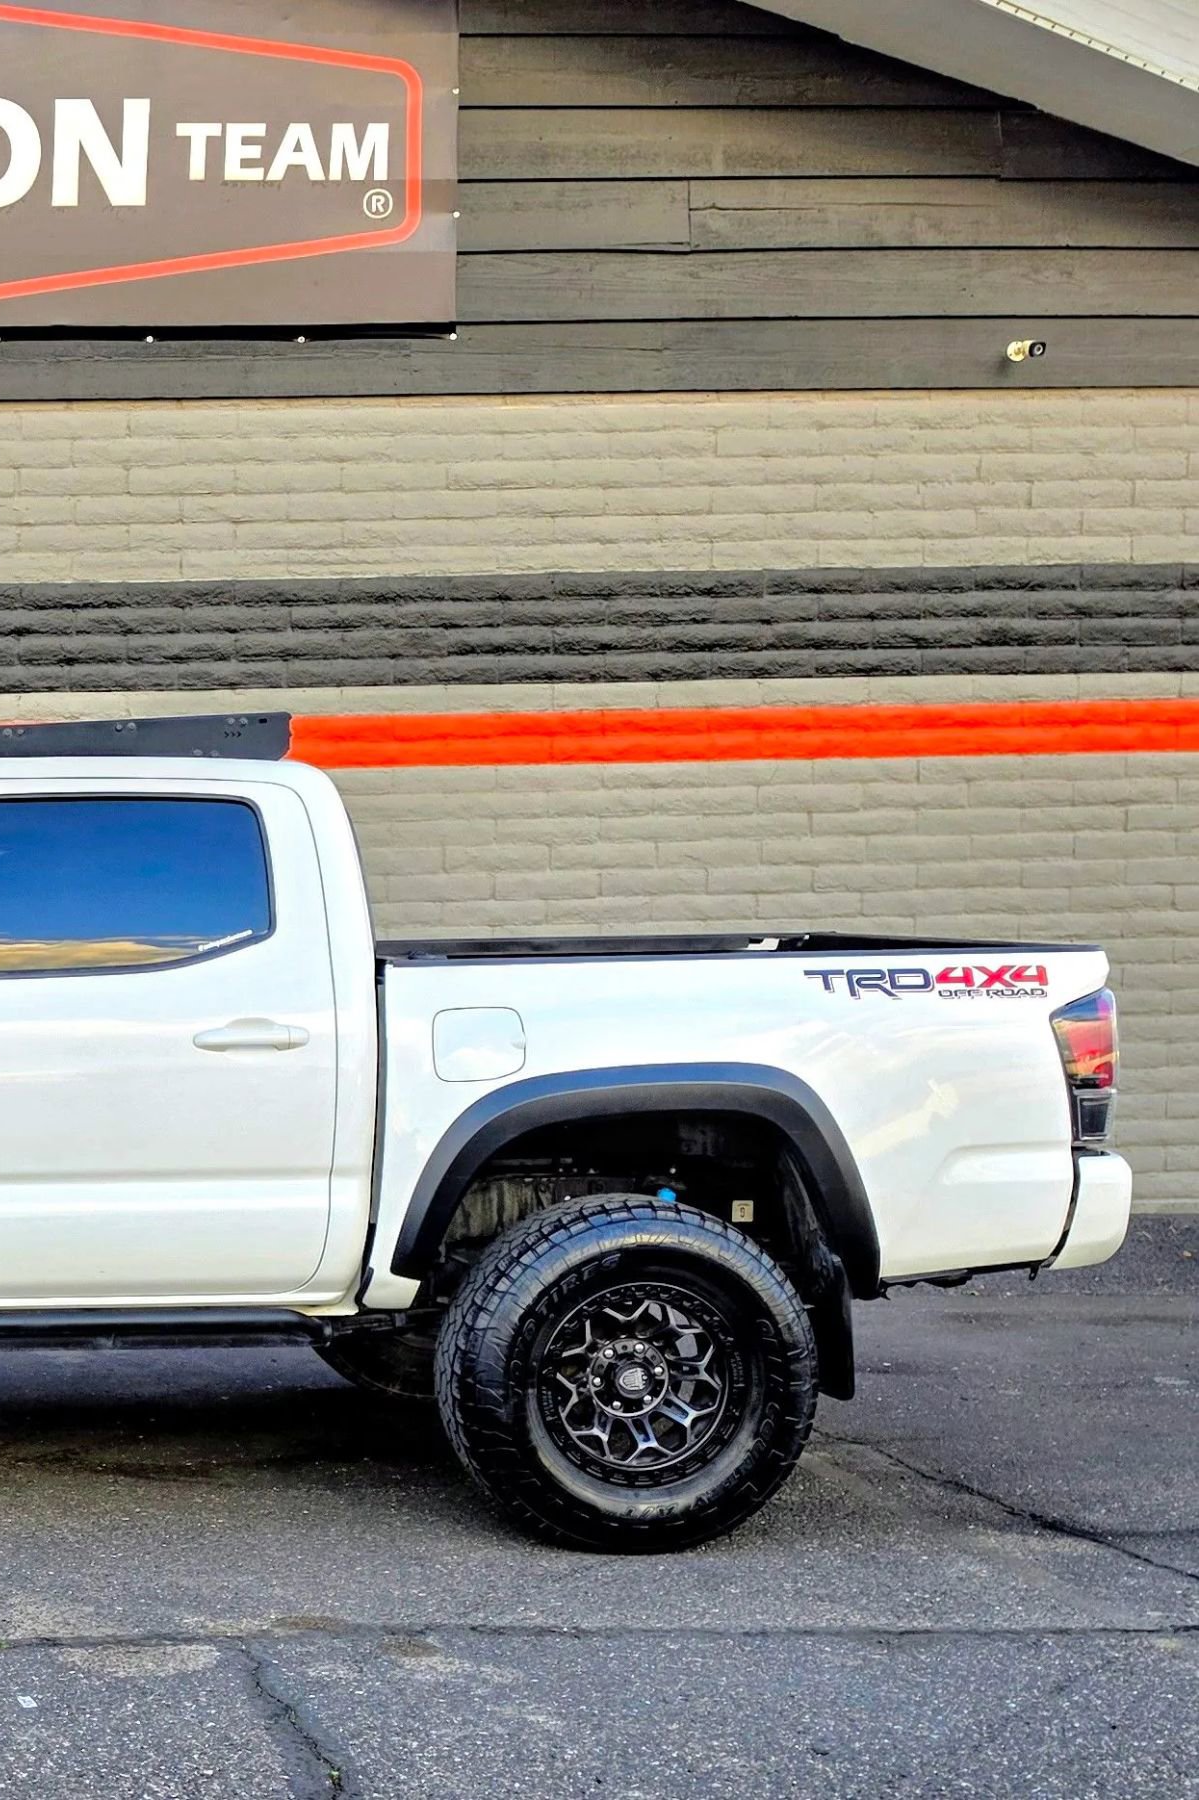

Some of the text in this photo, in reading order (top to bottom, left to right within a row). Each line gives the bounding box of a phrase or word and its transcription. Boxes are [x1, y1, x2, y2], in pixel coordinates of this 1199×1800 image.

[176, 122, 389, 181] TEAM
[803, 968, 935, 999] TRD
[938, 987, 1048, 999] OFF ROAD
